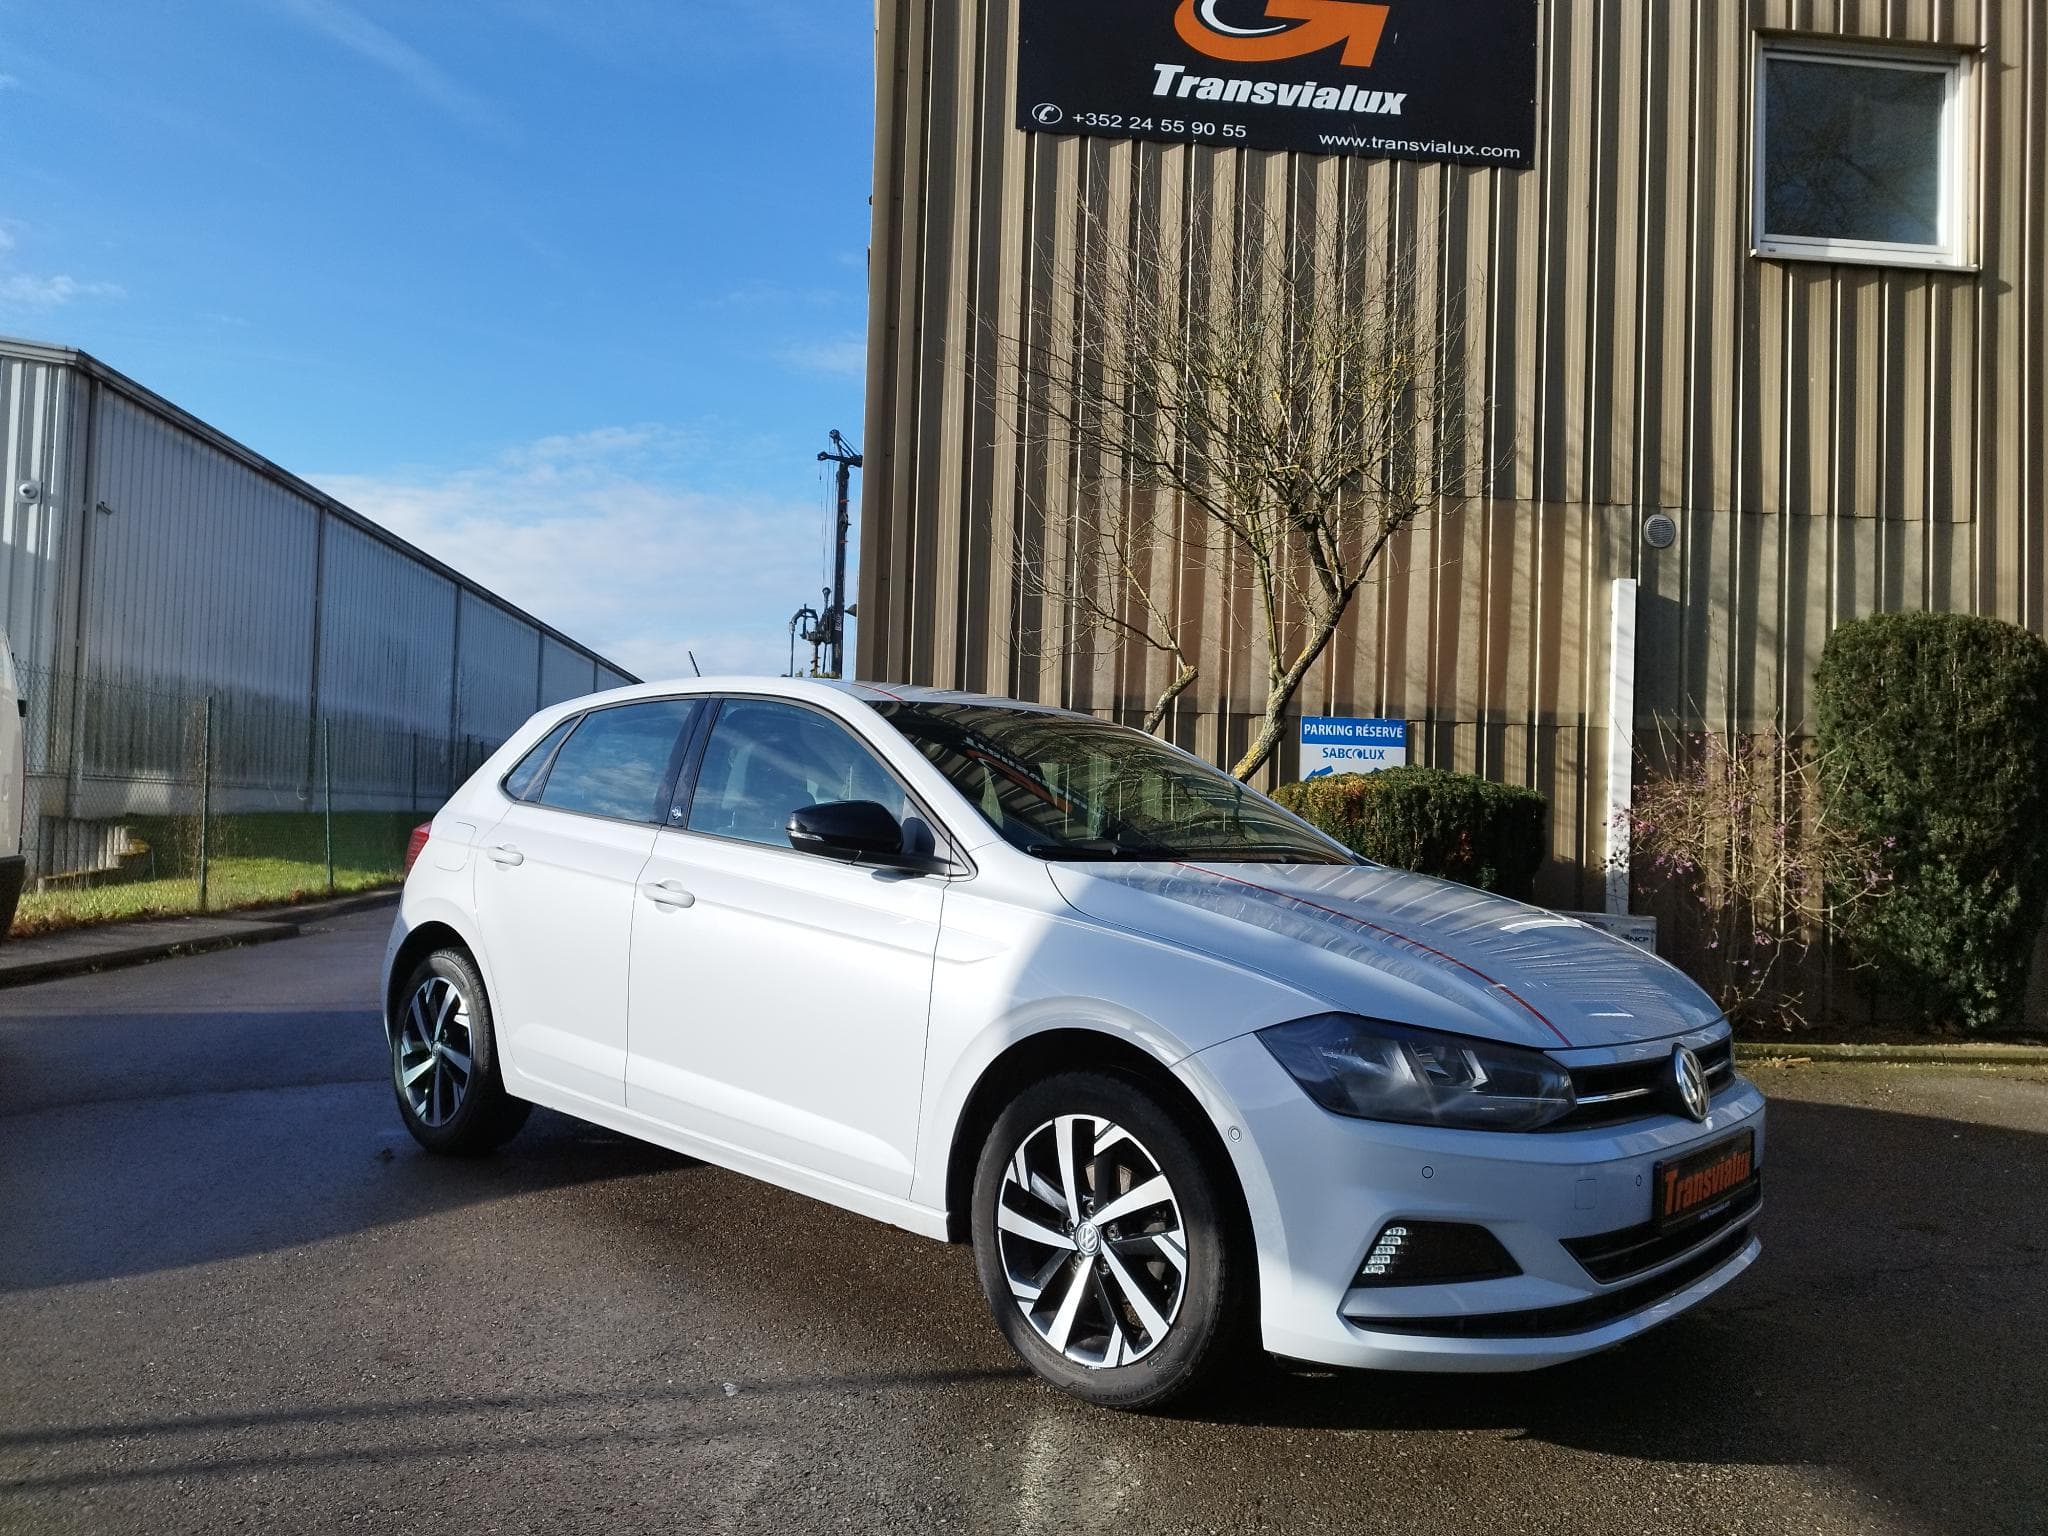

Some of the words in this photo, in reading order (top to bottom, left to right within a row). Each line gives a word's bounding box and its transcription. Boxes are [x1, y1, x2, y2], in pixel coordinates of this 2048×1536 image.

[1153, 63, 1408, 115] Transvialux
[1072, 112, 1123, 129] +352
[1128, 116, 1153, 131] 24
[1160, 119, 1185, 133] 55
[1191, 121, 1216, 136] 90
[1222, 124, 1247, 138] 55
[1319, 134, 1520, 159] www.transvialux.com
[1304, 723, 1353, 737] PARKING
[1355, 723, 1403, 739] RÉSERVÉ
